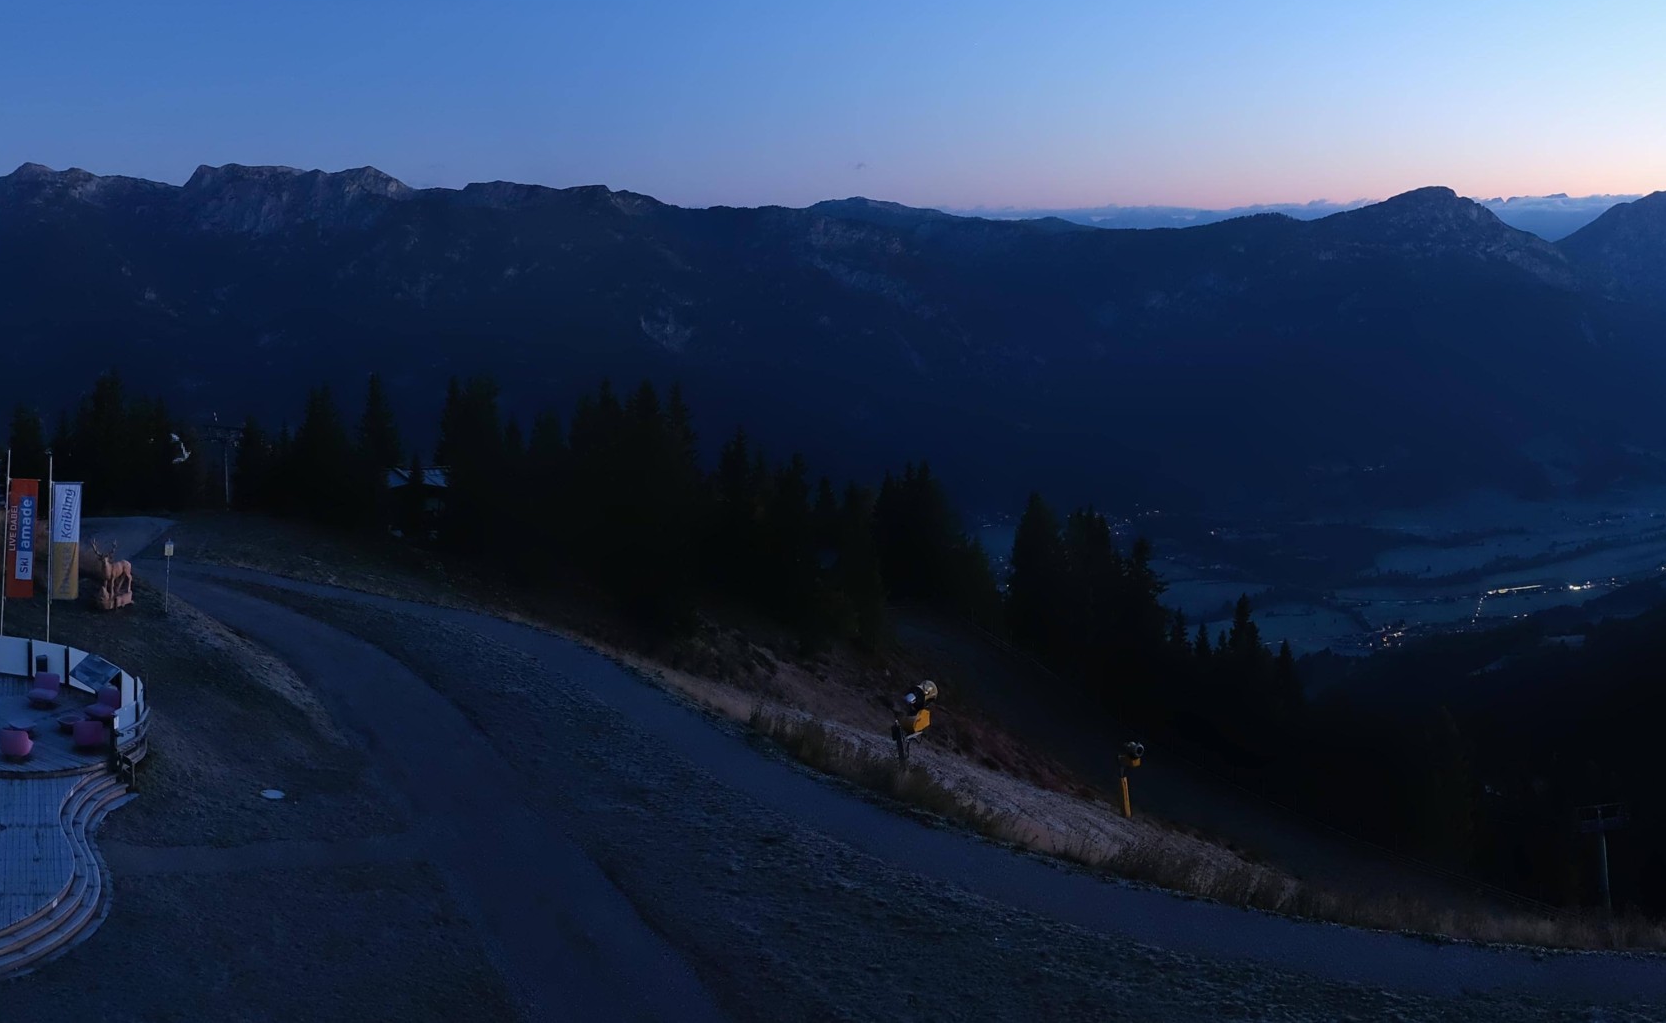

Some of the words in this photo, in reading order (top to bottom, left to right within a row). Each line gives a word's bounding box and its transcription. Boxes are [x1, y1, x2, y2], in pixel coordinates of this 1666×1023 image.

[21, 499, 33, 548] amade
[61, 489, 76, 538] Kaibling
[8, 533, 16, 551] LIVE
[20, 557, 28, 573] Ski
